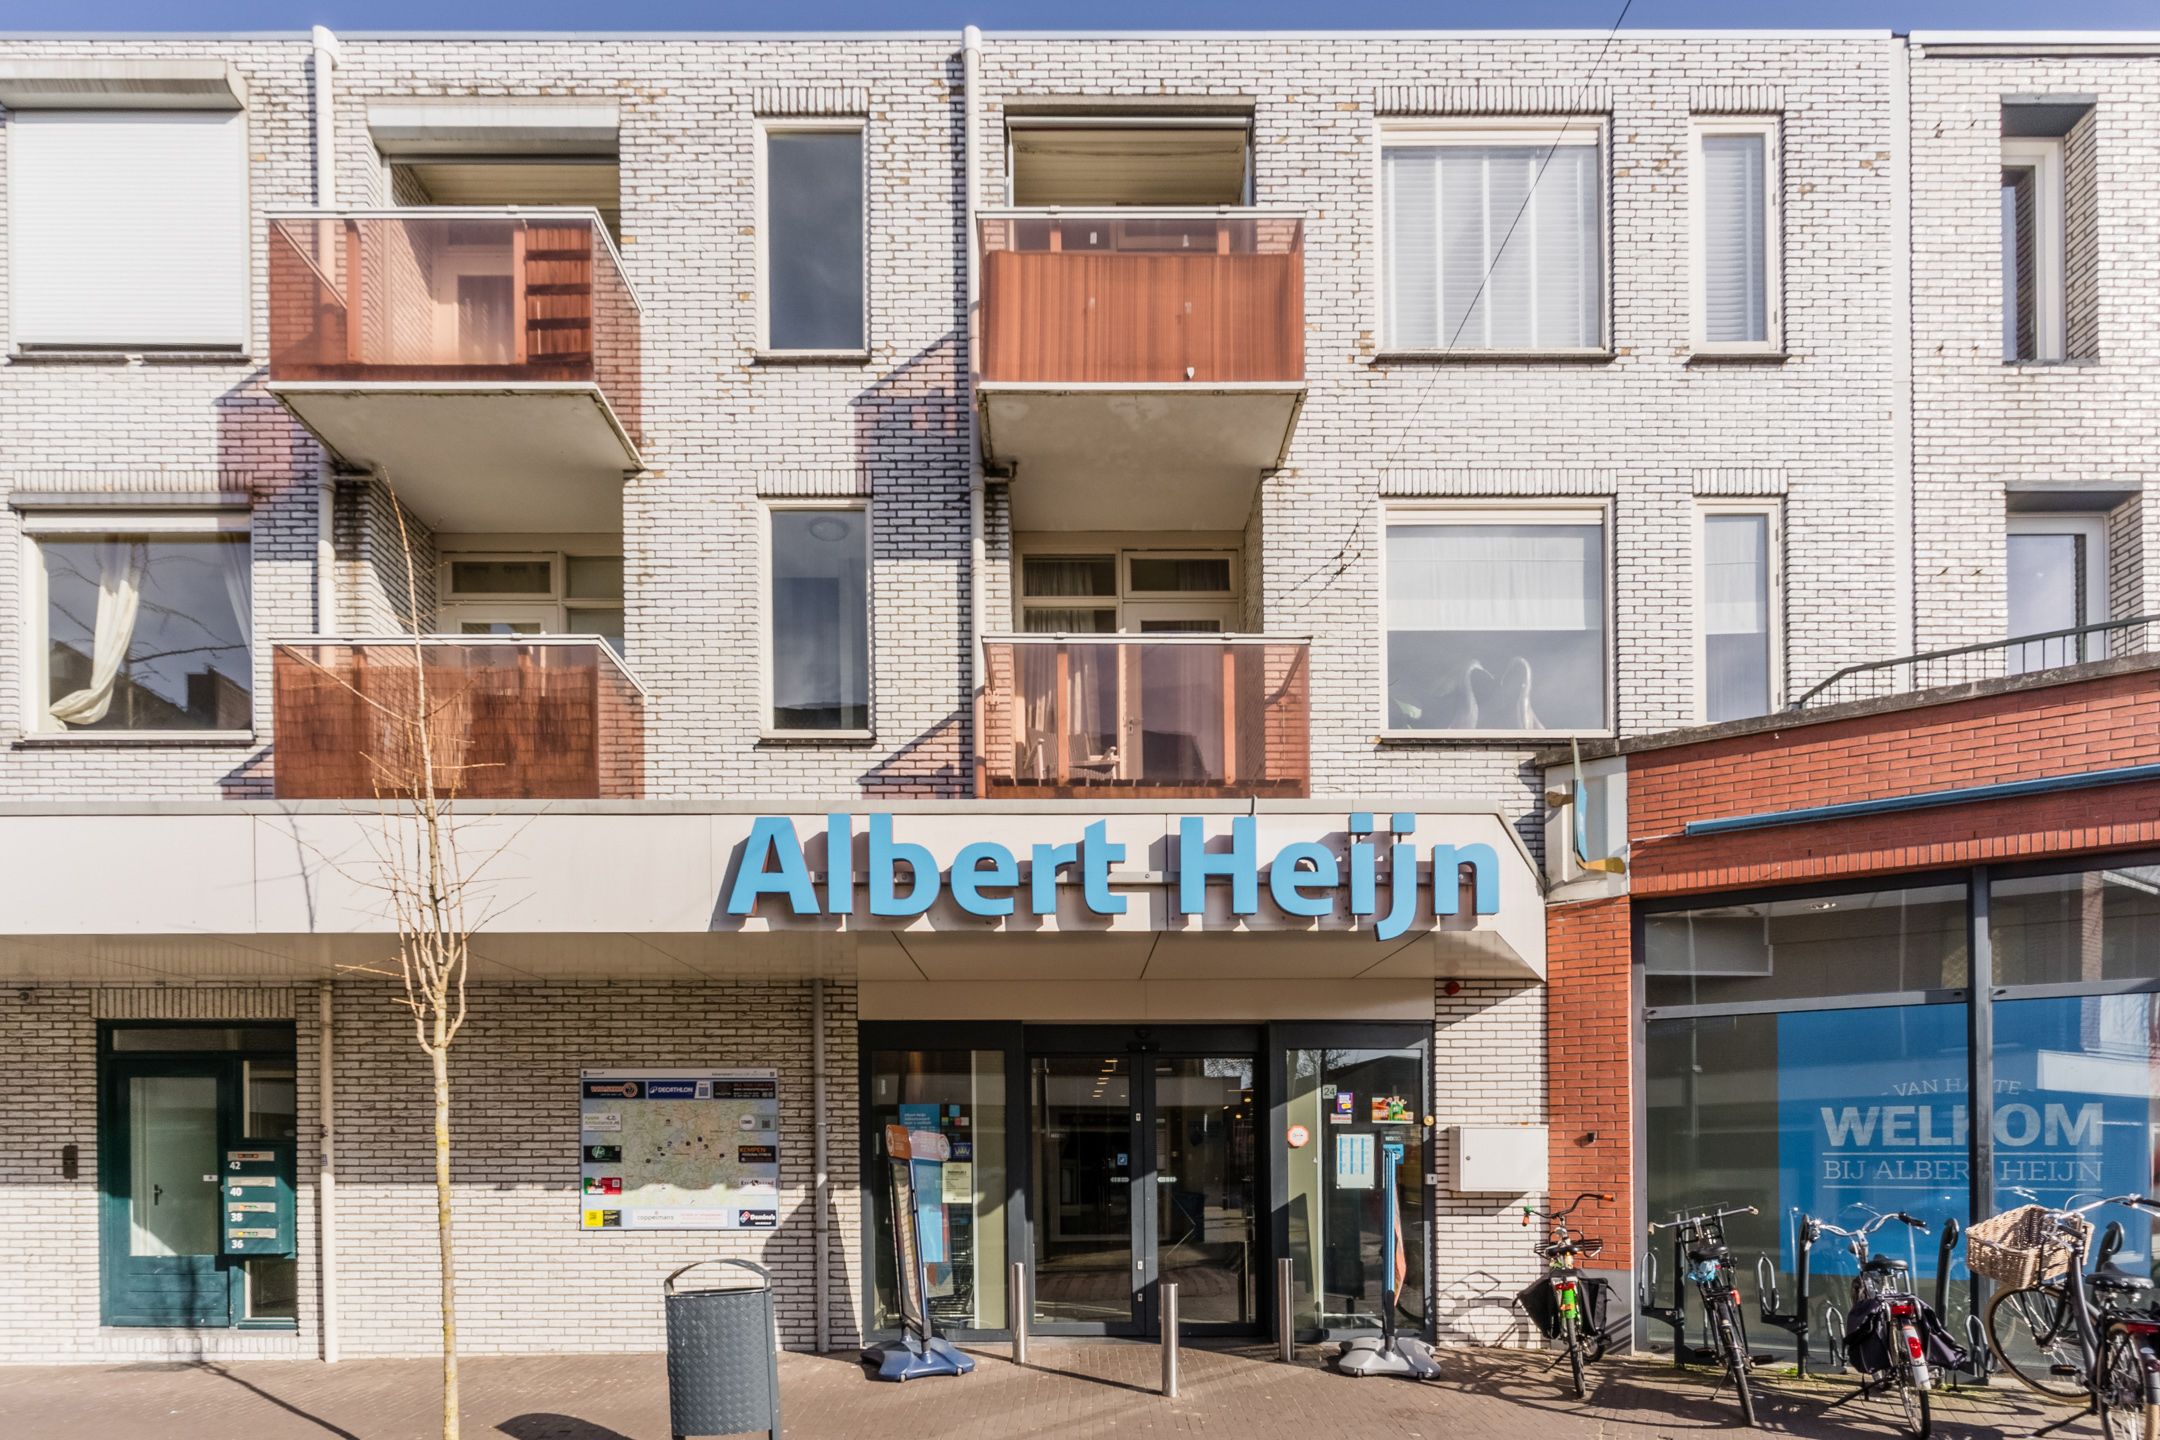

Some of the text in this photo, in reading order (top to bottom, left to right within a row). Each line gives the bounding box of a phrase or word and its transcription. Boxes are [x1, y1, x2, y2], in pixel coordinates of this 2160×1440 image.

[727, 812, 1499, 942] Albert Heijn
[1324, 1087, 1335, 1096] 24
[1892, 1077, 2022, 1097] VAN HTE
[230, 1162, 241, 1170] 42
[1823, 1160, 2103, 1182] BIJ ALBER HEIJN
[230, 1187, 242, 1196] 40
[230, 1212, 243, 1222] 38
[231, 1239, 244, 1249] 36
